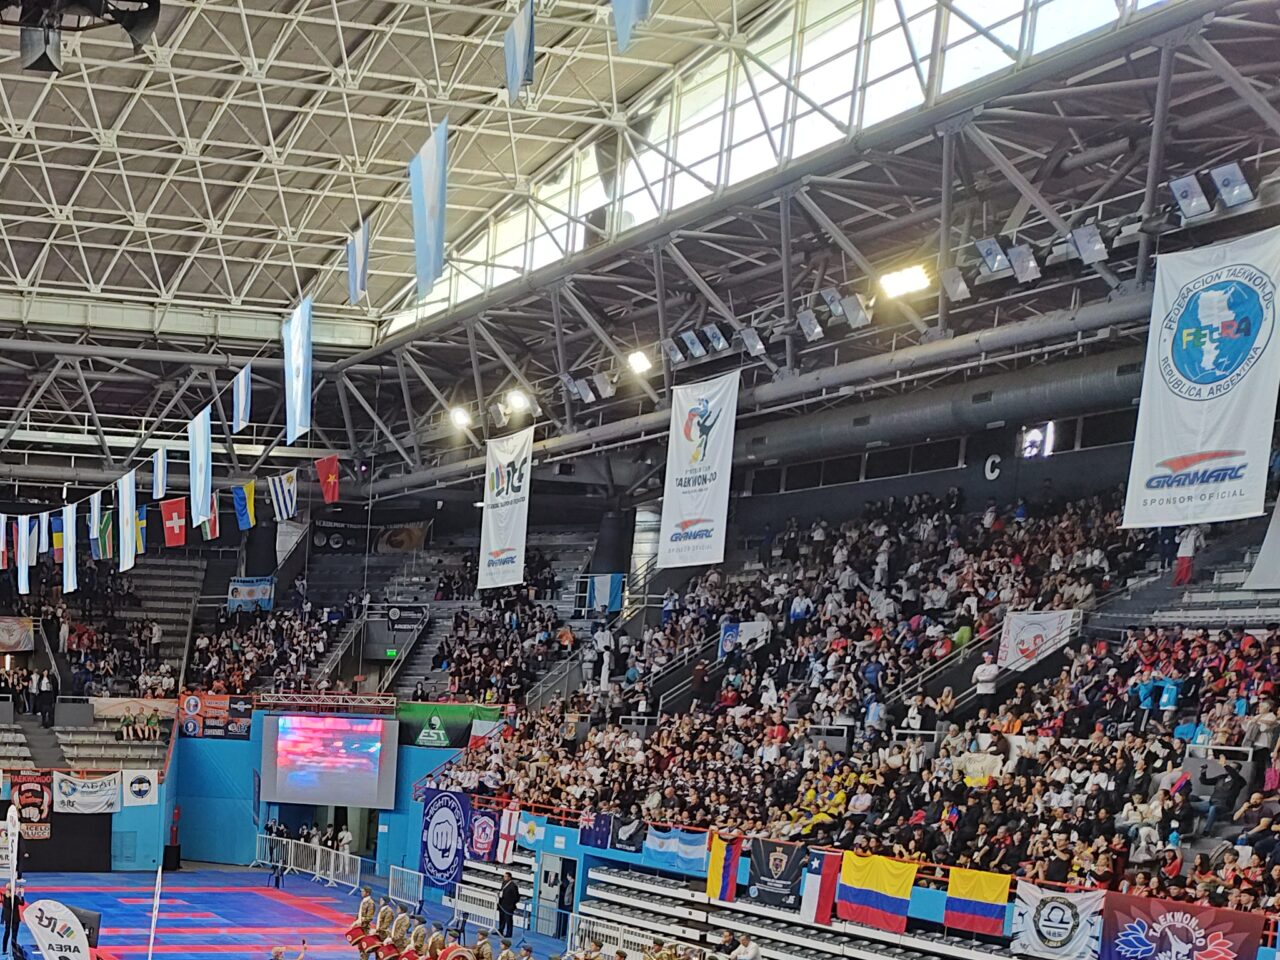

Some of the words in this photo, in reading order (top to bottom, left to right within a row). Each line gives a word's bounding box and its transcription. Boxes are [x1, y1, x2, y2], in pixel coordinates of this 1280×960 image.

[1164, 271, 1223, 331] FEDERACION
[1161, 356, 1202, 398] REPUBLICA
[1207, 345, 1261, 397] ARGENTINA
[984, 453, 1001, 480] C
[1145, 463, 1248, 489] GRANMARC
[1142, 495, 1194, 507] SPONSOR
[1200, 489, 1245, 502] OFICIAL
[419, 730, 446, 741] EST
[1148, 911, 1206, 947] TAEKWON-DO
